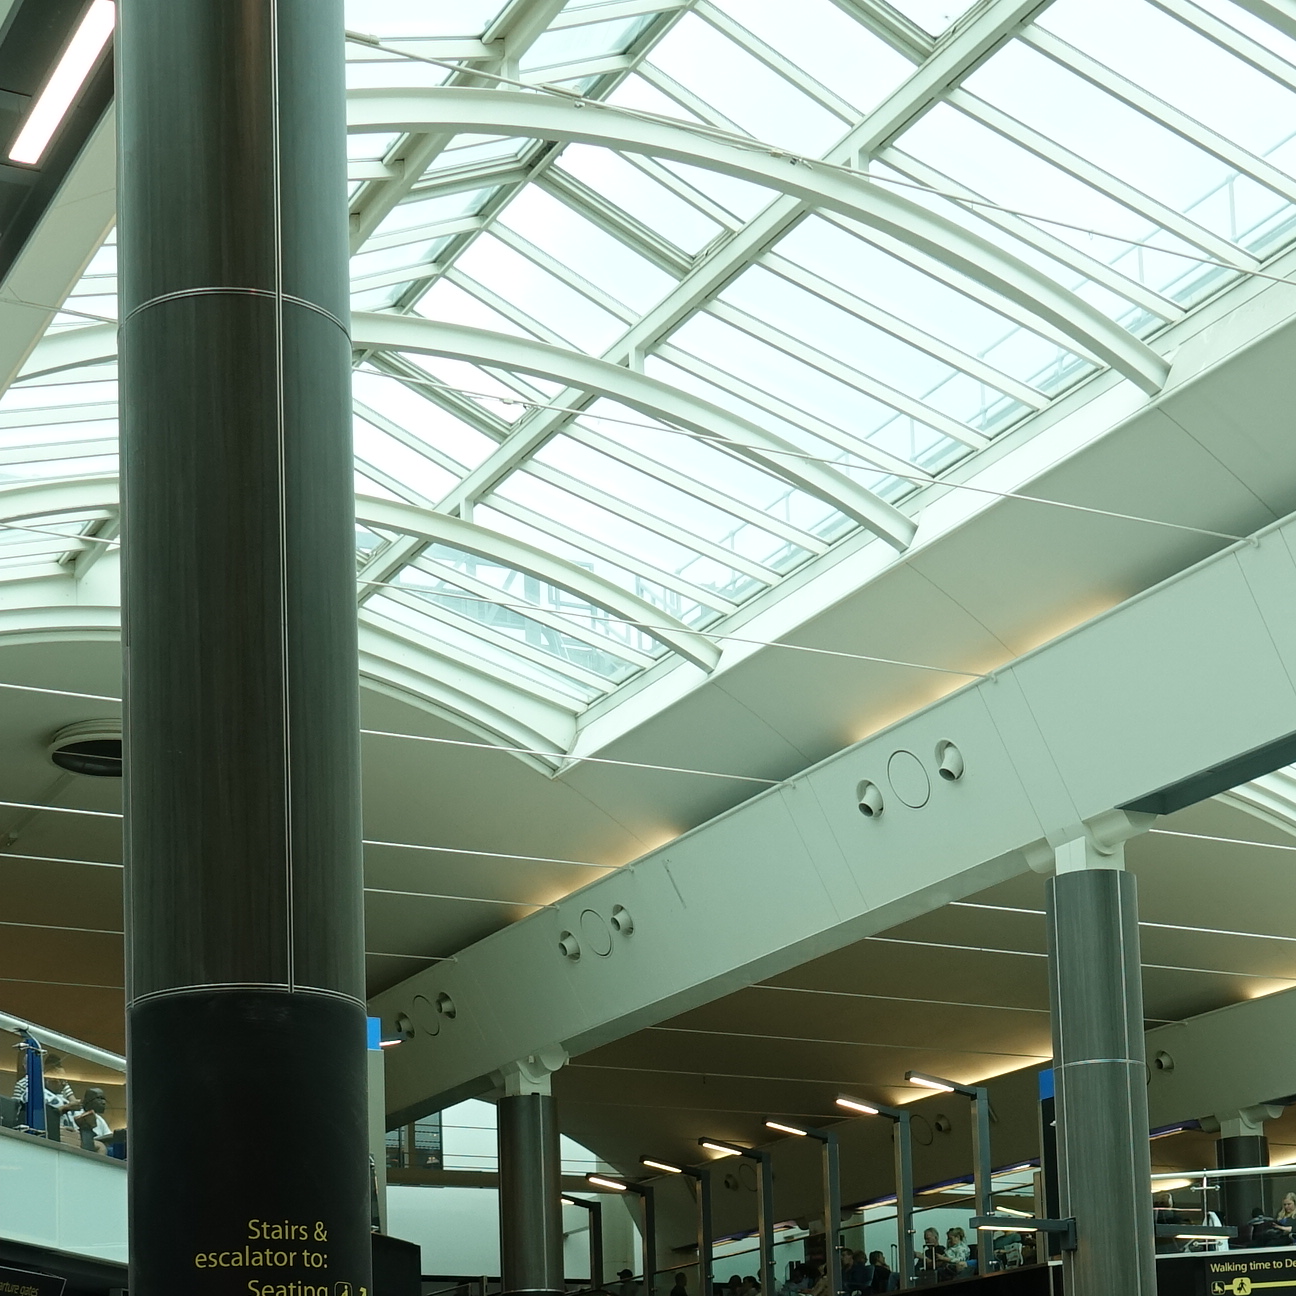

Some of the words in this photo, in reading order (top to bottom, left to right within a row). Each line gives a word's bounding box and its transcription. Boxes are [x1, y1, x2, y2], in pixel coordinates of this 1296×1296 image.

[248, 1218, 308, 1242] Stairs
[313, 1221, 328, 1242] &
[195, 1246, 297, 1269] escalator
[302, 1249, 328, 1269] to:
[1210, 1263, 1248, 1273] Walking
[1249, 1260, 1271, 1270] time
[1272, 1260, 1284, 1269] to
